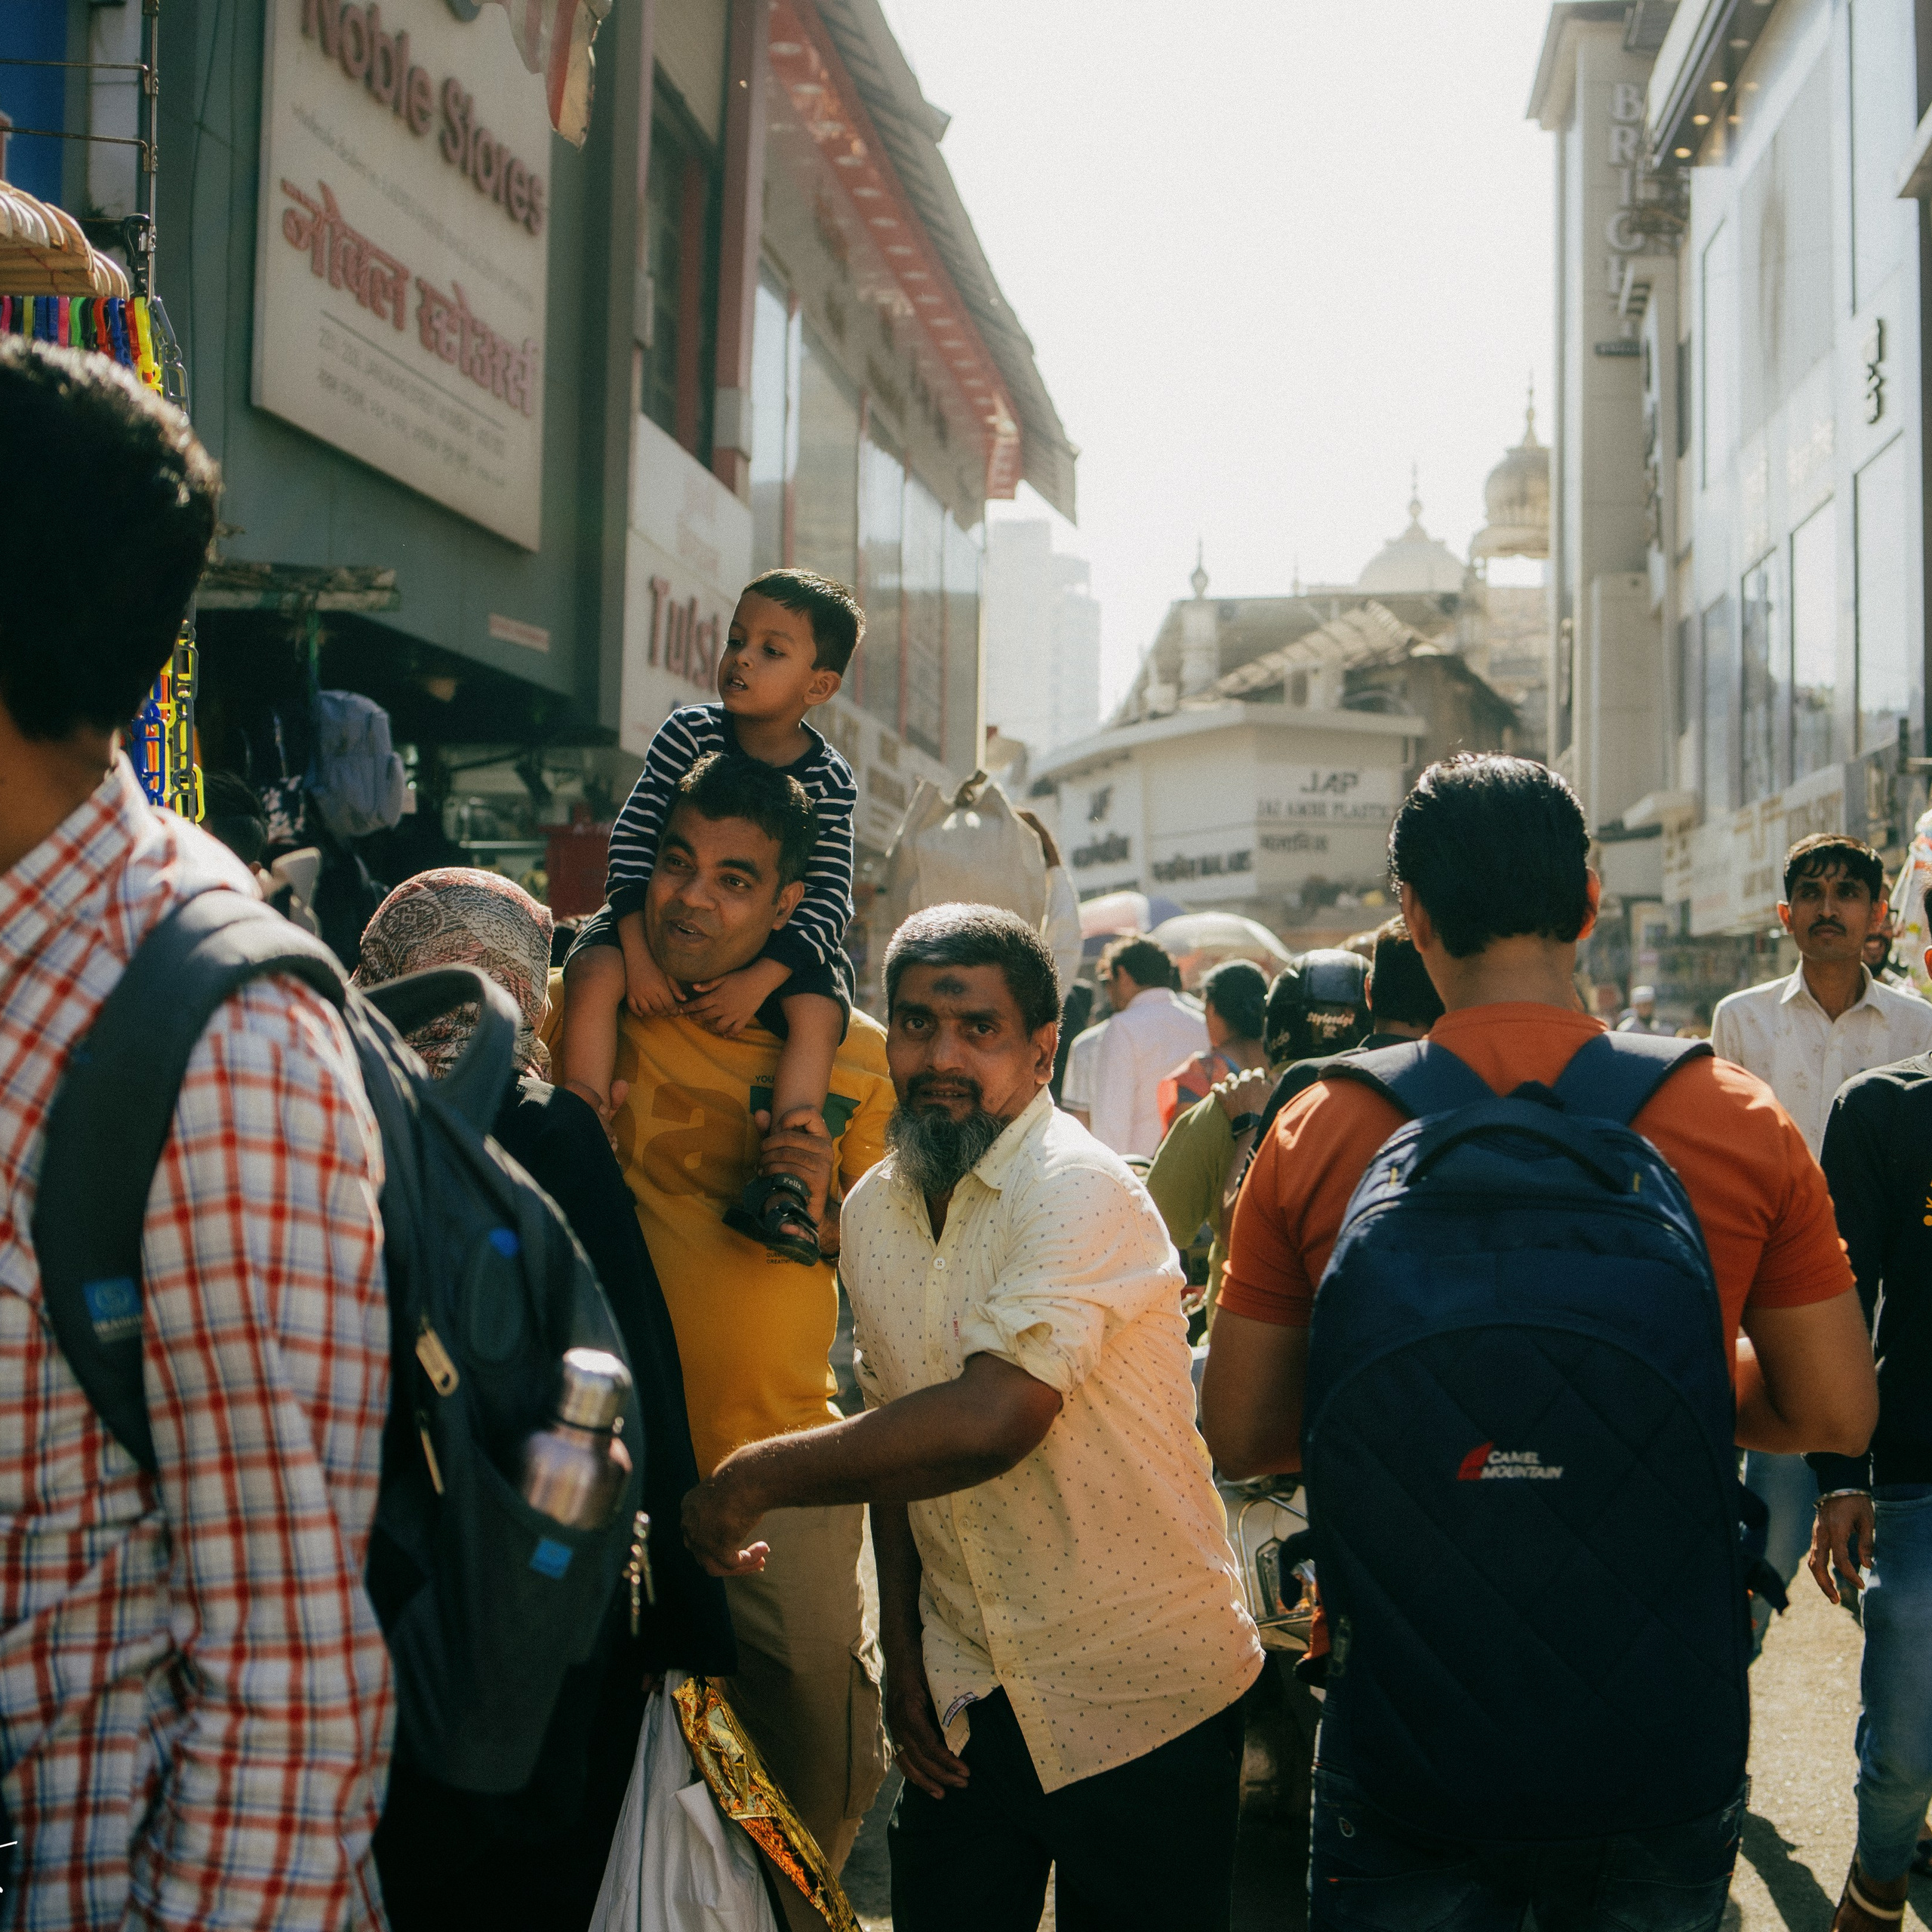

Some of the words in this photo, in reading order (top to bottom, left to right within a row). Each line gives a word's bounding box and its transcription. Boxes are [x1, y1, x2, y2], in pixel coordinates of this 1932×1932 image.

[437, 75, 545, 237] Stores
[280, 178, 411, 332] नोबल
[783, 1177, 802, 1190] Felix
[1487, 1450, 1541, 1465] CAMEL
[1480, 1464, 1564, 1480] MOUNTAIN
